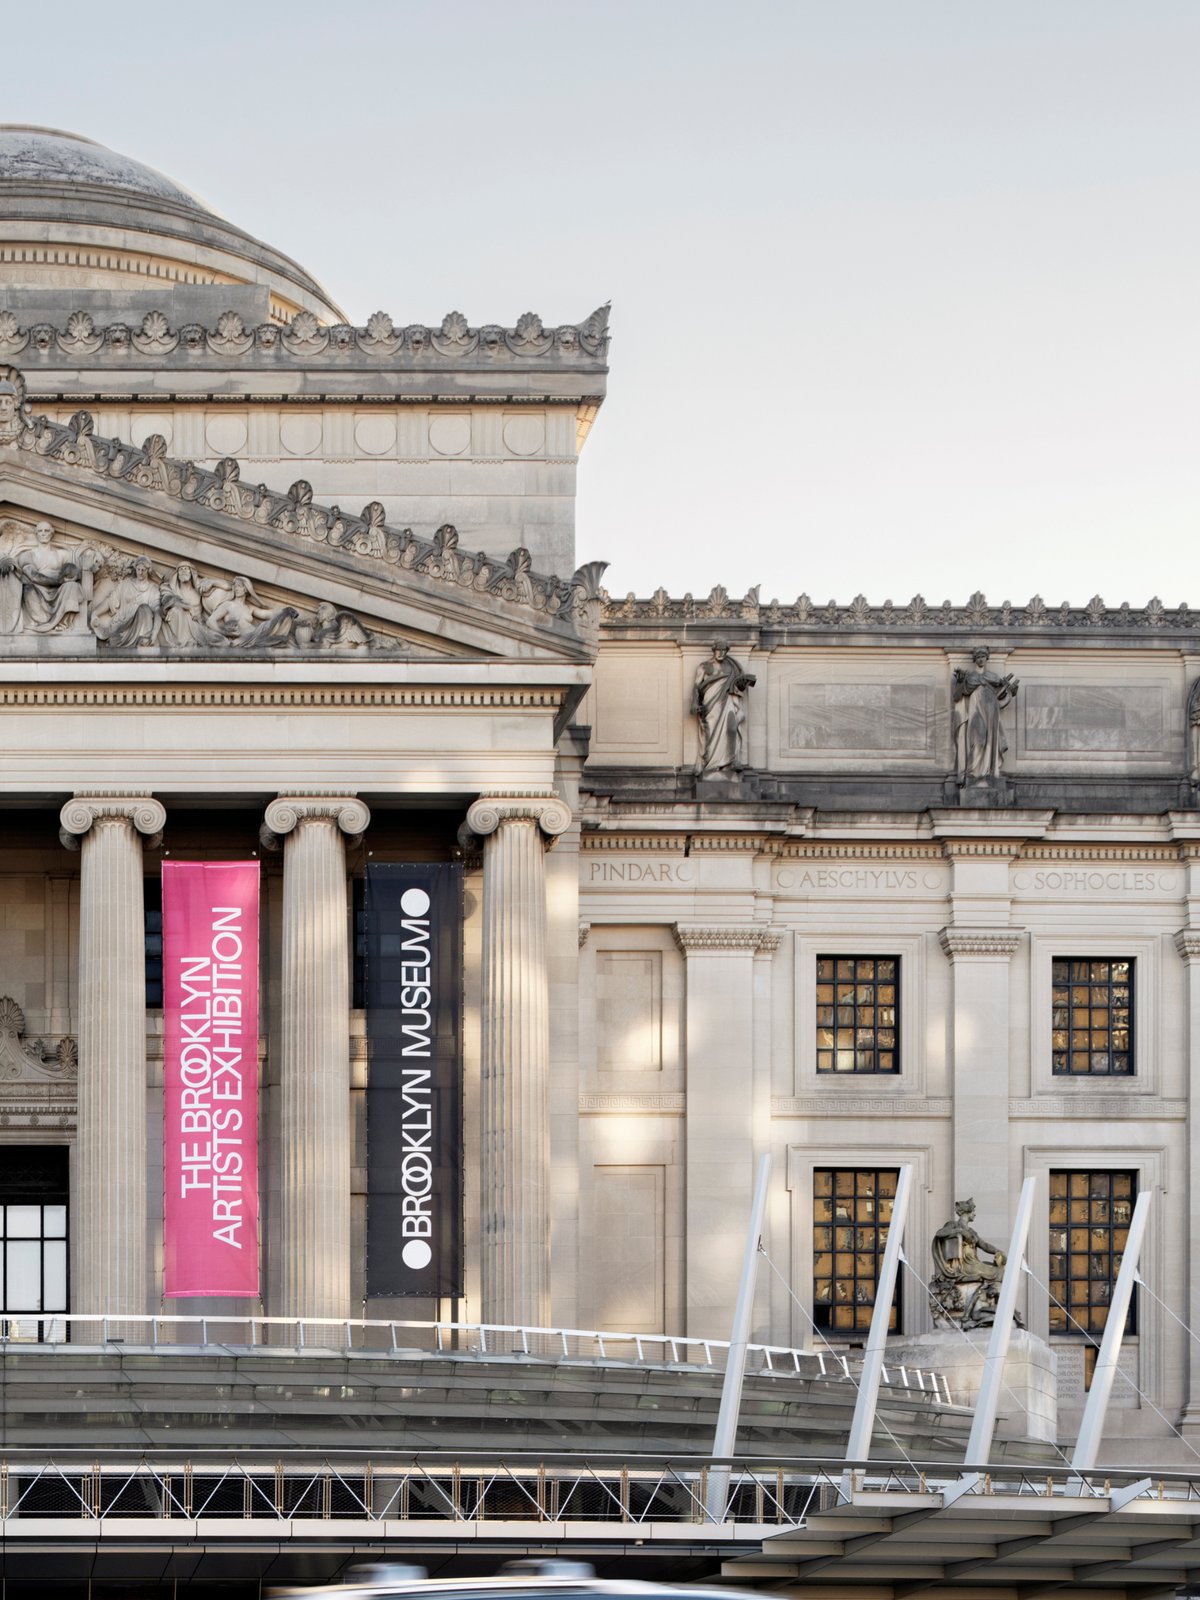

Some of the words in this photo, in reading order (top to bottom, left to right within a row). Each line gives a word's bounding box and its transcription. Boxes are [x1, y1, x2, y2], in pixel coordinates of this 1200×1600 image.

[590, 863, 673, 882] PINDAR
[800, 870, 918, 889] AESCHYLVS
[1034, 872, 1155, 890] SOPHOCLES
[180, 956, 211, 1133] BROOKLYN
[212, 906, 242, 1100] EXHIBITION
[401, 919, 431, 1057] MUSEUM
[181, 1142, 211, 1199] THE
[212, 1108, 242, 1249] ARTISTS
[402, 1069, 432, 1237] BROOKLYN
